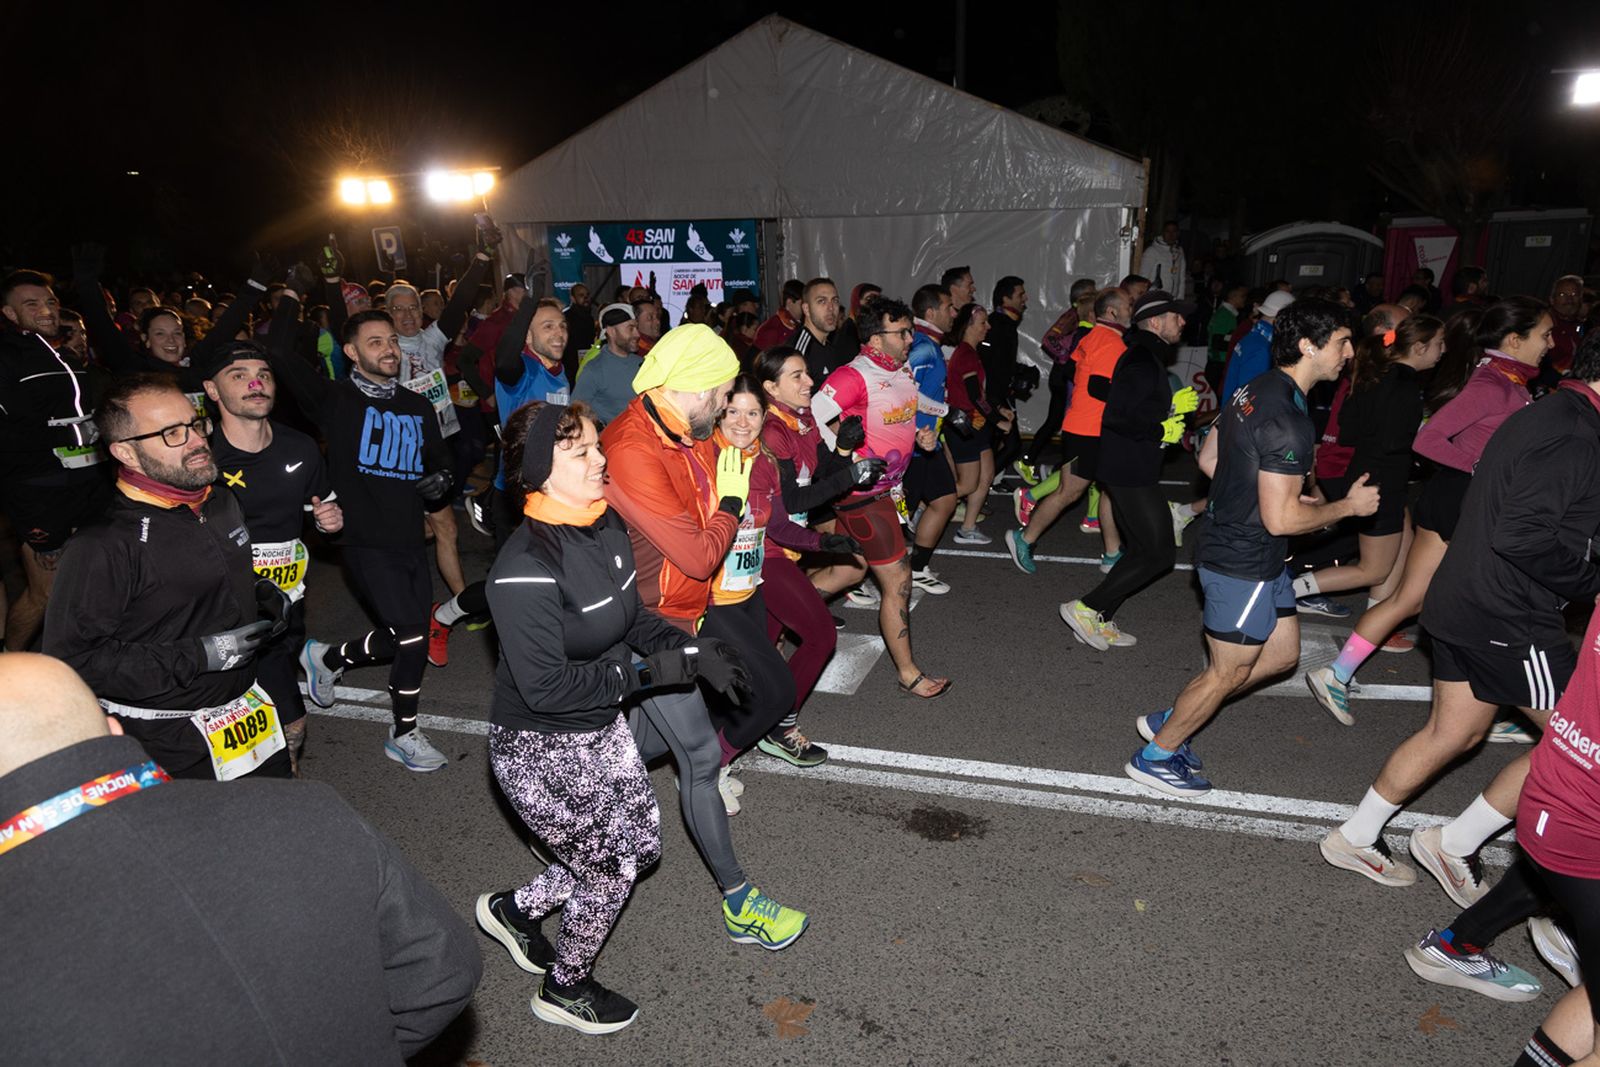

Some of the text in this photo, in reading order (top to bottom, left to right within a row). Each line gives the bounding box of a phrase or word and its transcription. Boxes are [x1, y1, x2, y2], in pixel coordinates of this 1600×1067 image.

[623, 243, 674, 260] ANTÓN
[421, 384, 445, 400] 457
[359, 406, 423, 472] CORE
[357, 465, 406, 481] Training
[208, 718, 226, 732] SAN
[223, 709, 268, 750] 4089
[86, 773, 136, 800] NOCHE
[62, 794, 85, 813] DE
[17, 807, 58, 832] SAN
